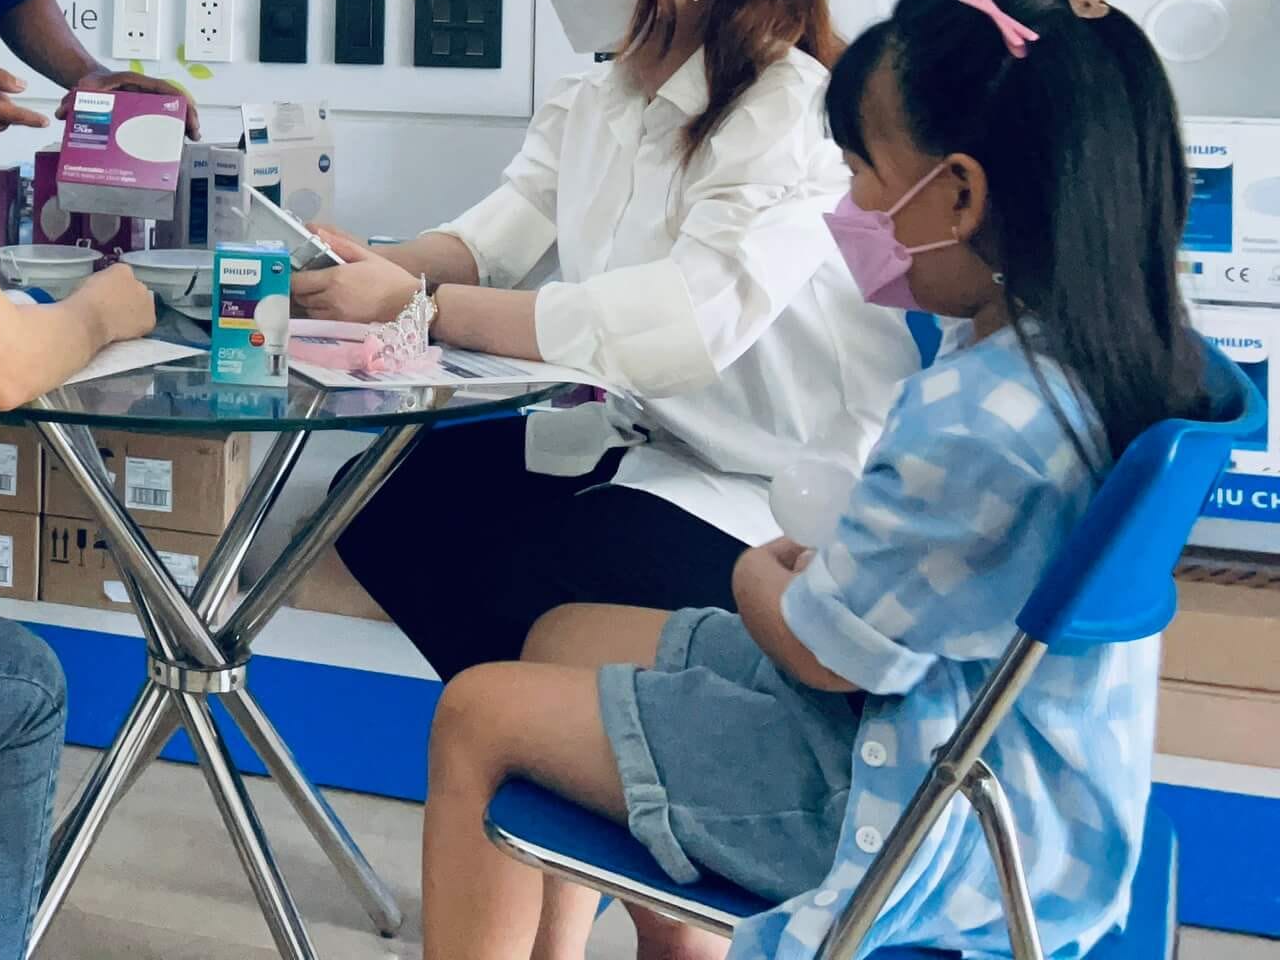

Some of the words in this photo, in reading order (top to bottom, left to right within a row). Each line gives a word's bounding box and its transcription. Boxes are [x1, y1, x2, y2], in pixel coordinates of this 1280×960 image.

[78, 98, 111, 107] PHILIPS
[253, 166, 279, 177] PHILIPS
[223, 266, 258, 278] PHILIPS
[1209, 487, 1243, 509] ỊU
